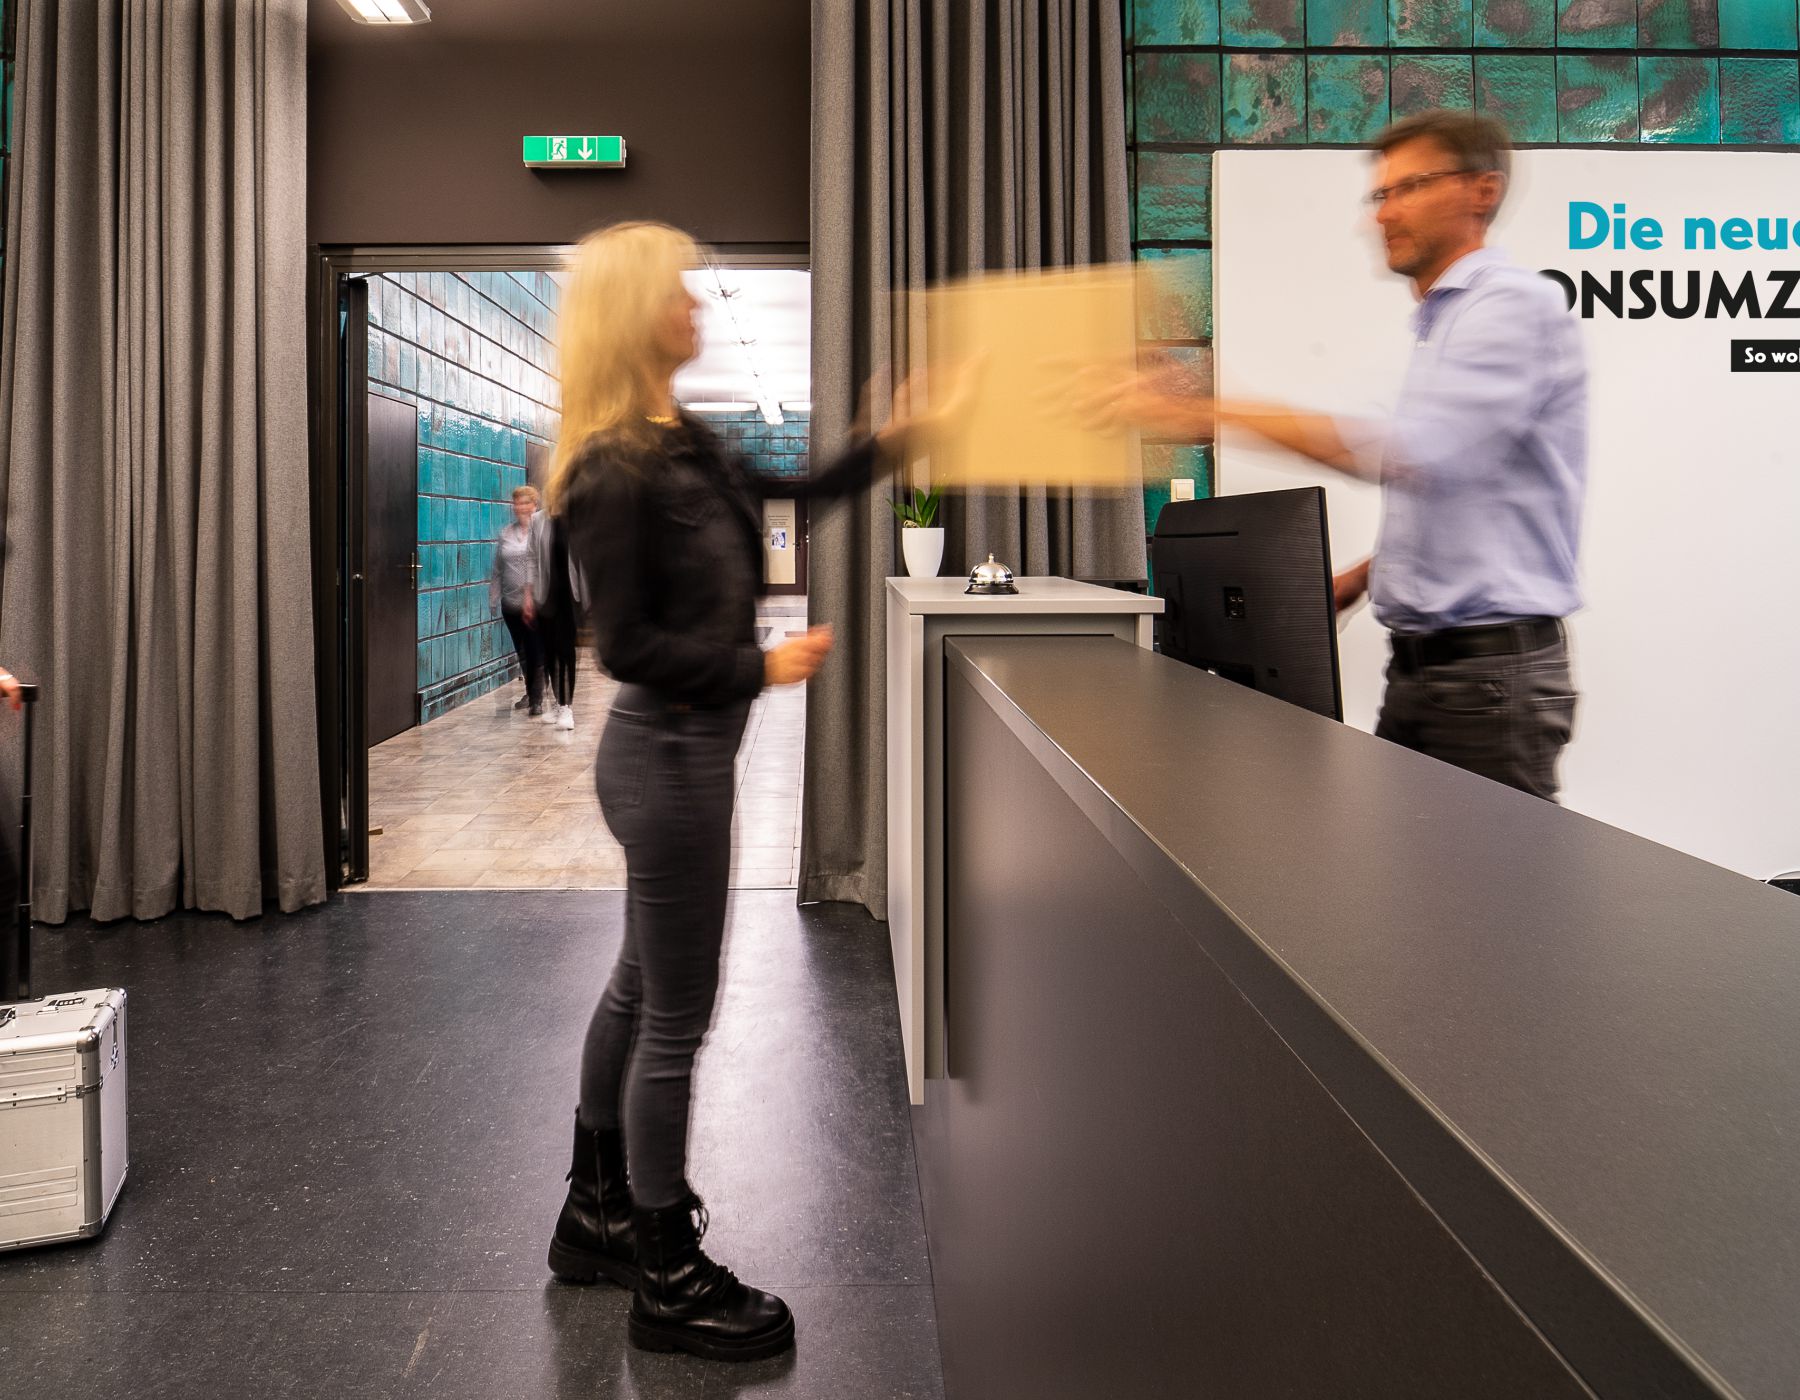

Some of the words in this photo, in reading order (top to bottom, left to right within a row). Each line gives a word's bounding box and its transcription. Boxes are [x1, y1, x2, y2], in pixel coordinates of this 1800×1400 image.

[1568, 201, 1663, 250] Die
[1684, 217, 1800, 250] neu
[1744, 346, 1767, 363] So
